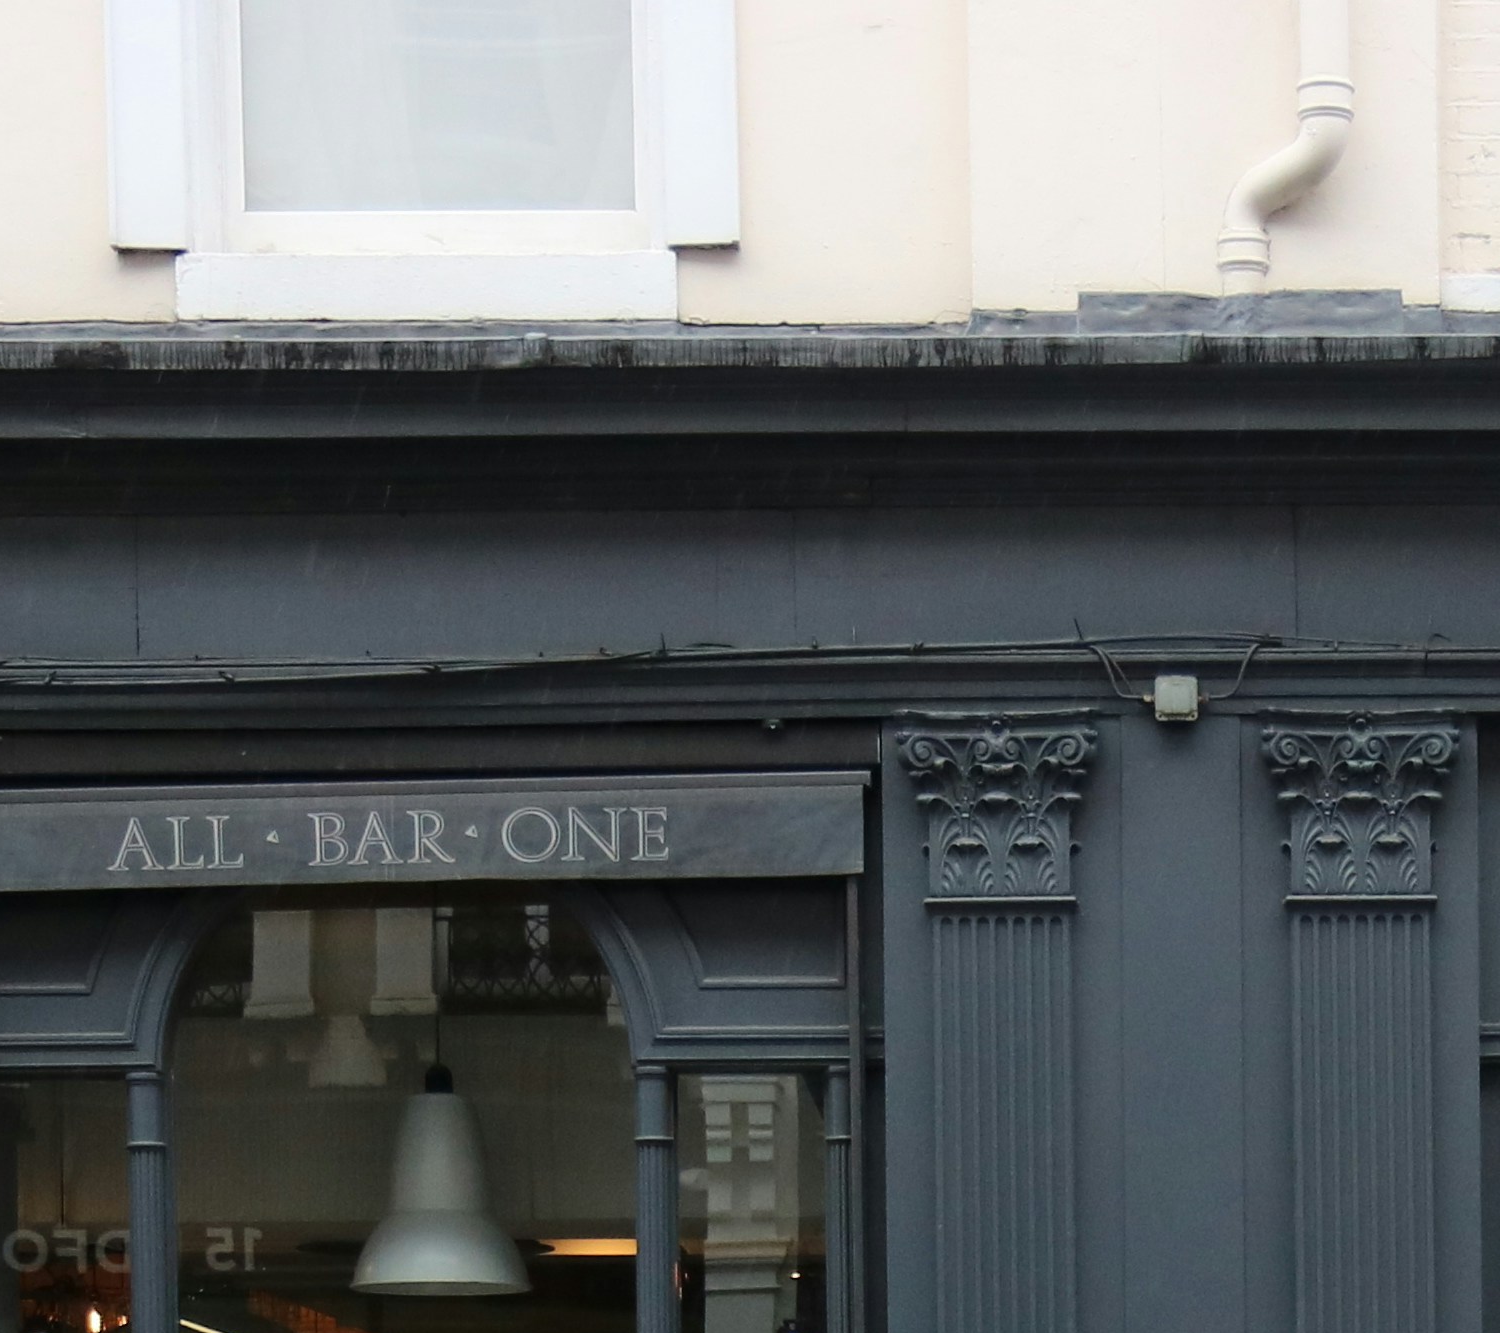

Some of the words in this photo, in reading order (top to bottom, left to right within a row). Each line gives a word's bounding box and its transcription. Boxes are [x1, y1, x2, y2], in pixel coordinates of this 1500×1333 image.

[107, 814, 244, 871] ALL
[307, 809, 455, 867] BAR
[501, 806, 669, 863] ONE
